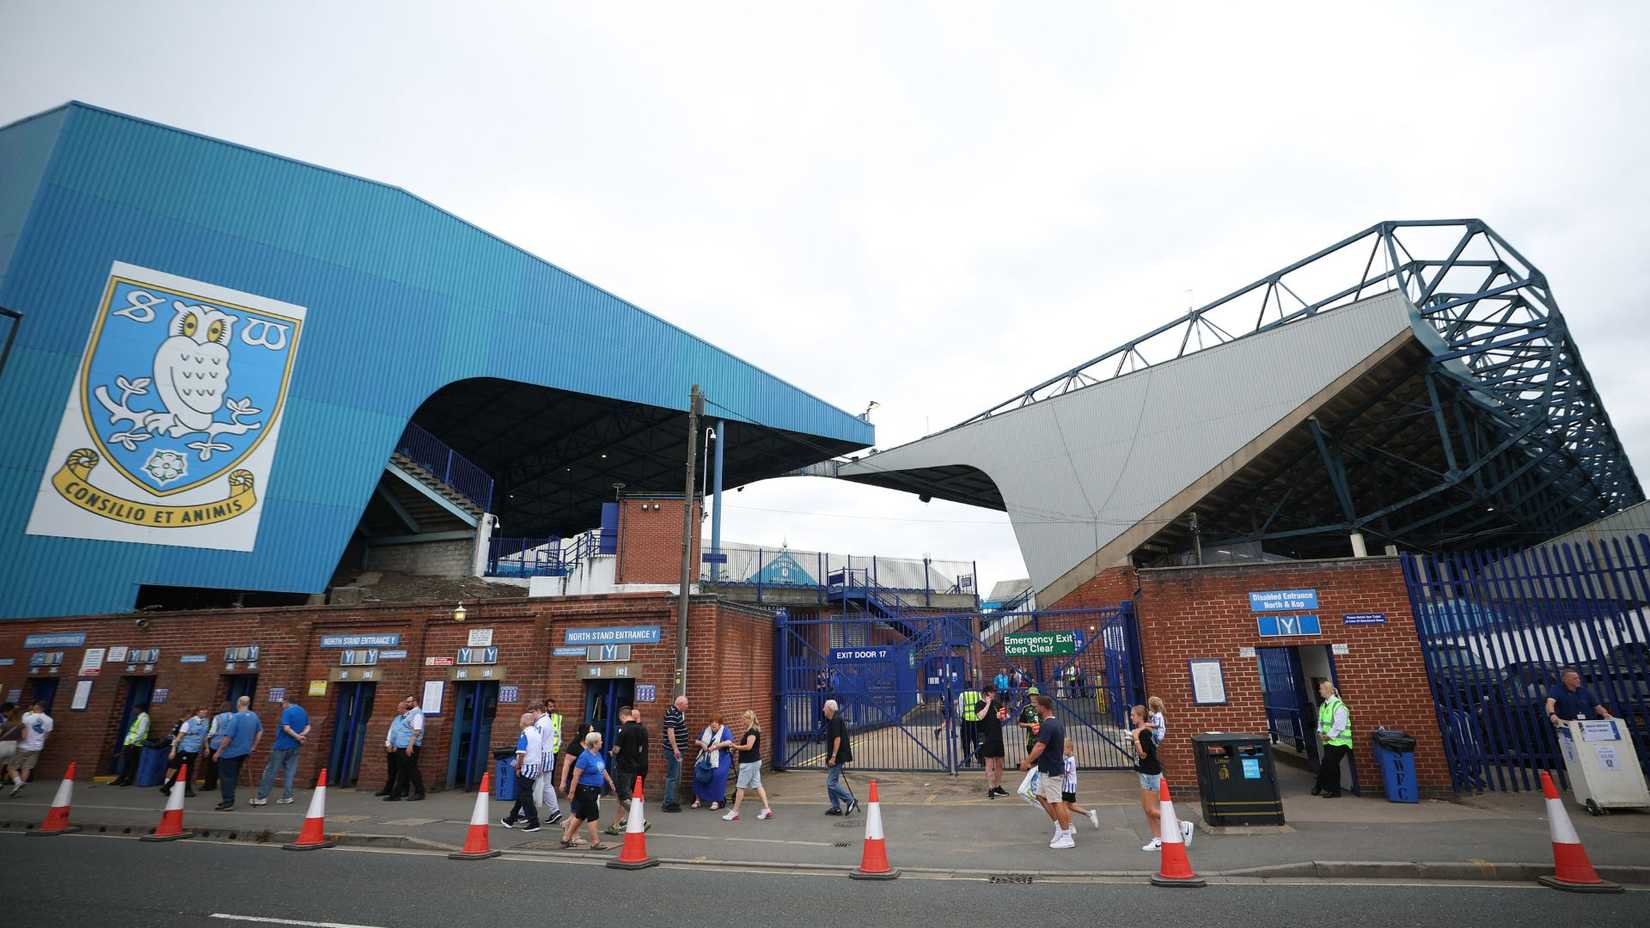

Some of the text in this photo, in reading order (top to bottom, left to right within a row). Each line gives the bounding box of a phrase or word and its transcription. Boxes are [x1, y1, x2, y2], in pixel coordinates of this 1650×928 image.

[64, 481, 243, 524] CONSILIO ET ANIMIS
[1252, 592, 1313, 601] Disabled Entrance
[1264, 601, 1283, 609] North
[1291, 600, 1305, 609] Kop
[1280, 618, 1294, 634] Y
[568, 630, 657, 641] NORTH STAND ENTRANCE Y
[1003, 634, 1073, 646] Emergency Exit
[461, 648, 471, 661] Y
[487, 648, 495, 661] Y
[605, 644, 615, 659] Y
[836, 650, 887, 660] EXIT DOOR 17
[1004, 644, 1054, 655] Keep Clear
